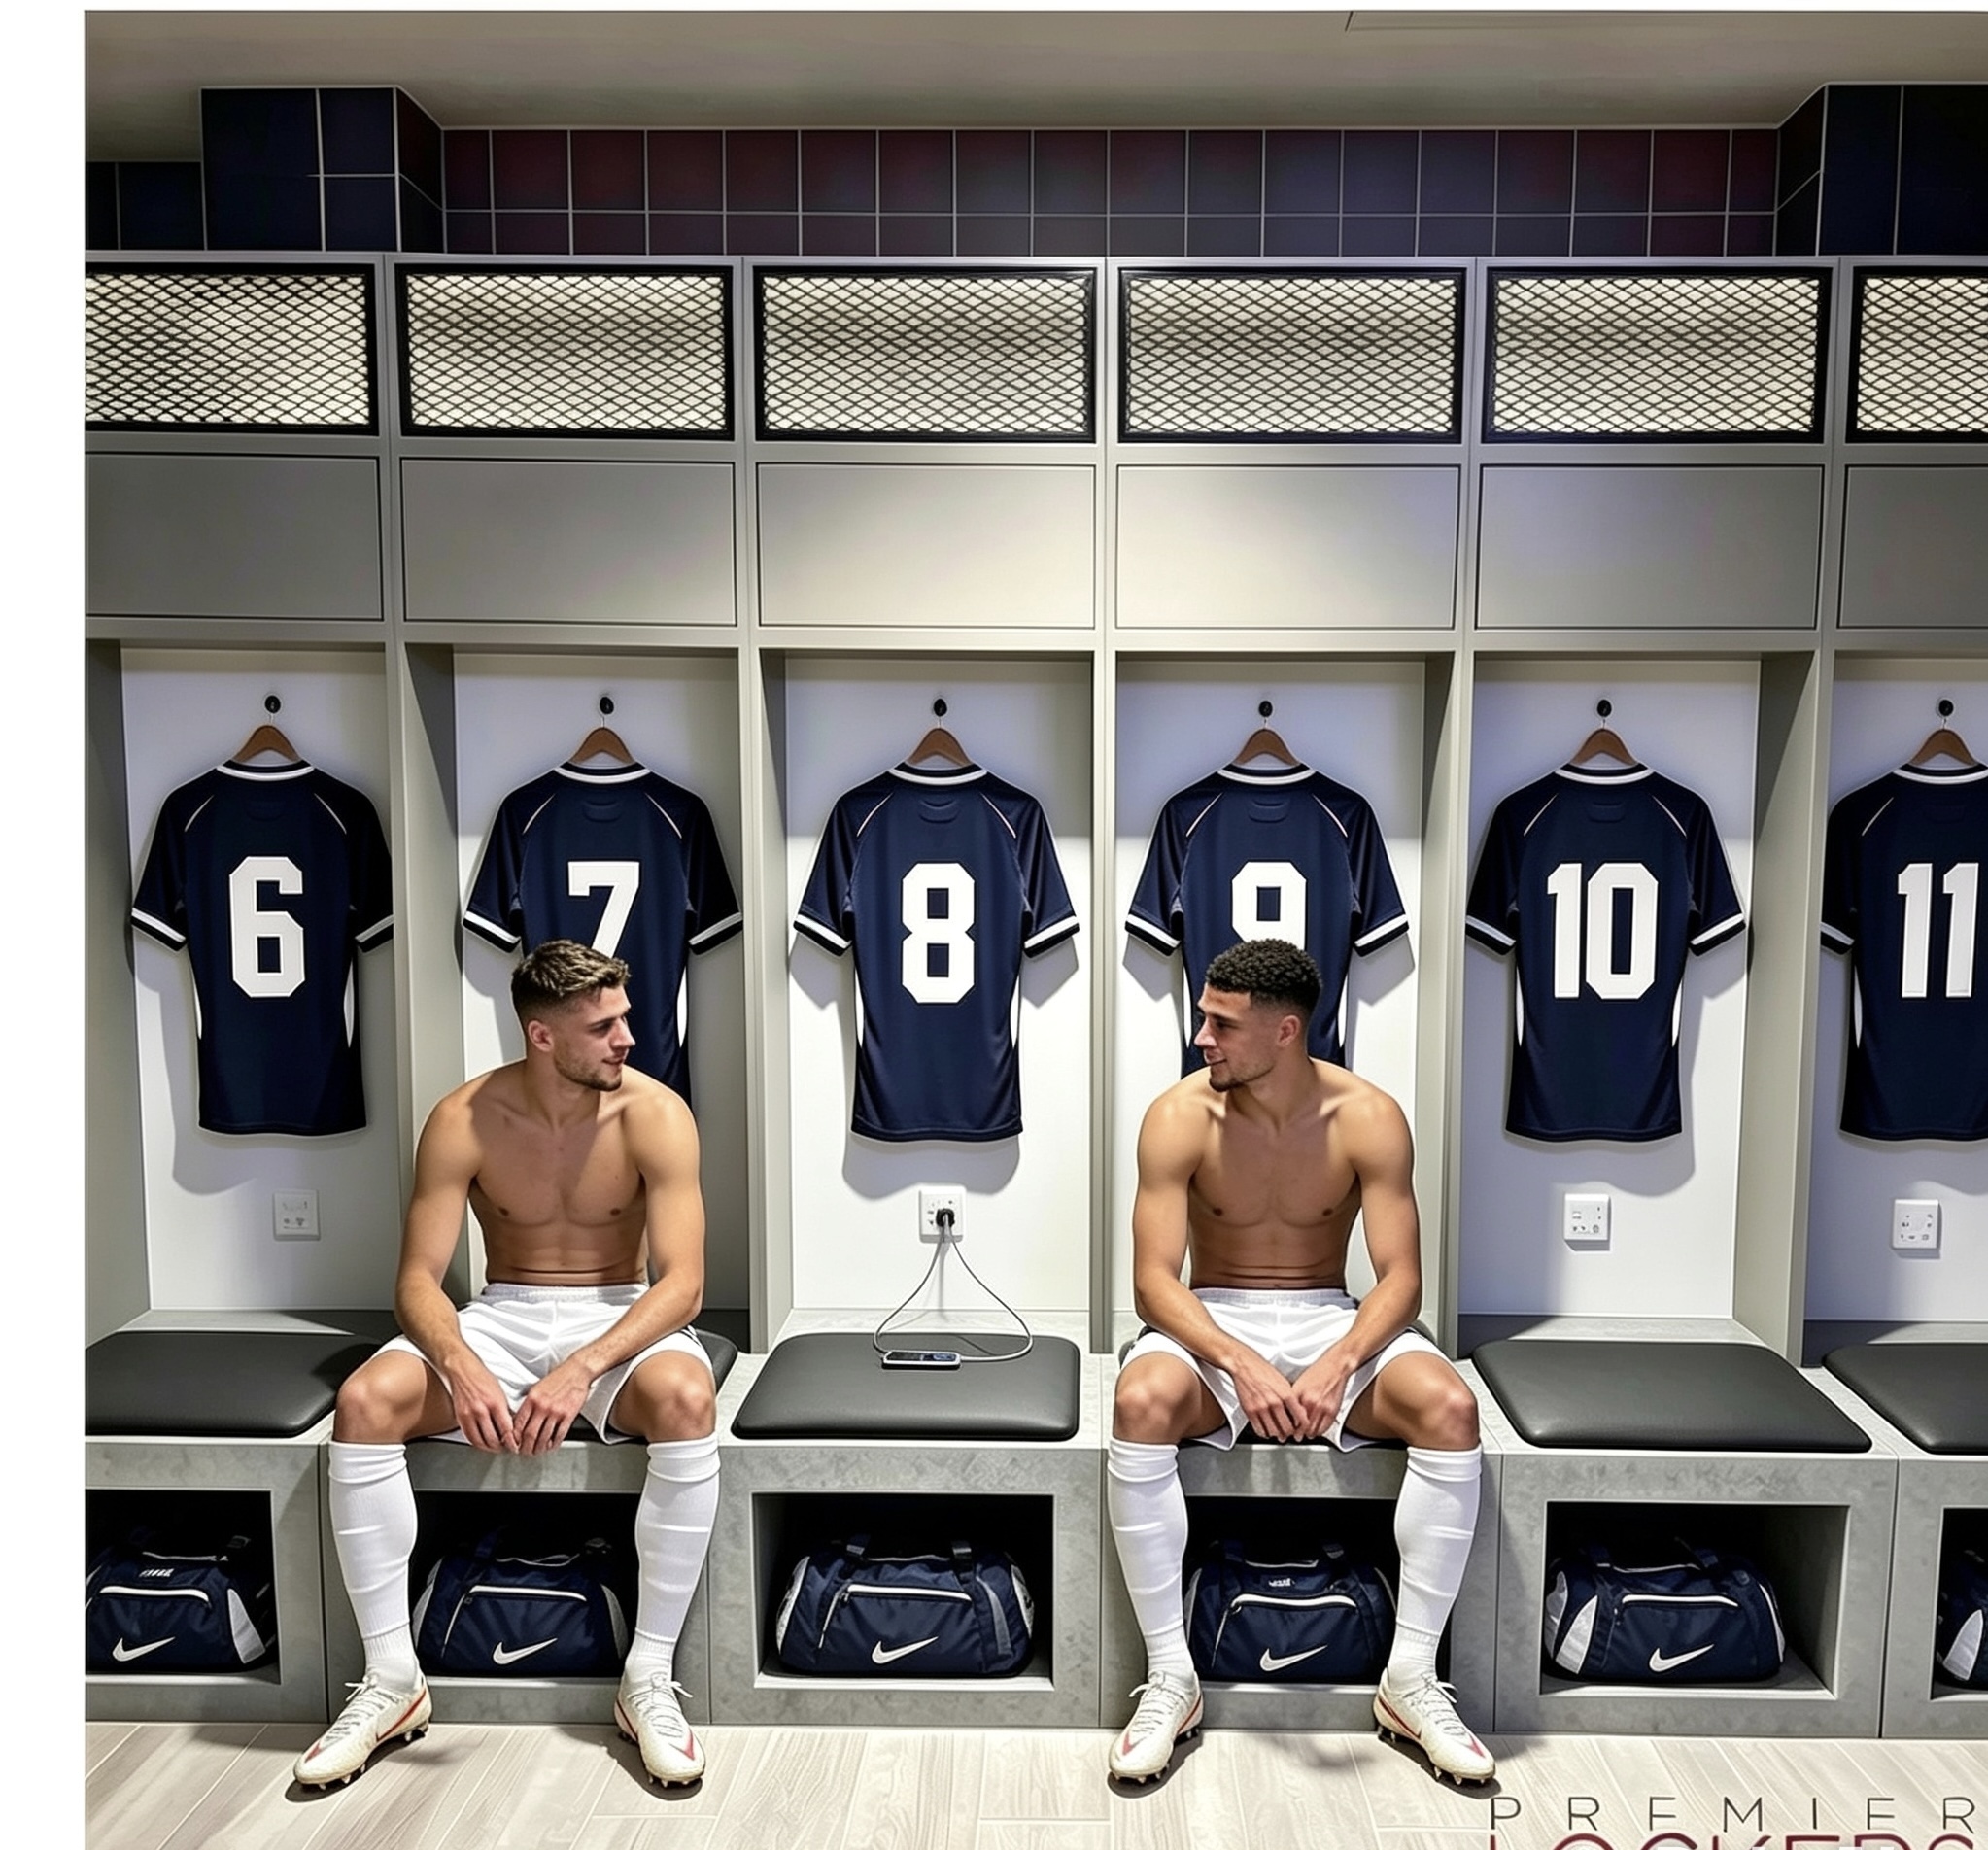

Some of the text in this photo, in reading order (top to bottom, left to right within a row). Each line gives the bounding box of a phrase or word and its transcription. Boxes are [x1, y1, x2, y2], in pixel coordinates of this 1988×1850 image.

[229, 856, 305, 998] 6
[567, 861, 640, 958] 7
[902, 862, 975, 1004] 8
[1231, 861, 1307, 952] 9
[1547, 862, 1659, 1000] 10
[1898, 862, 1979, 998] 11
